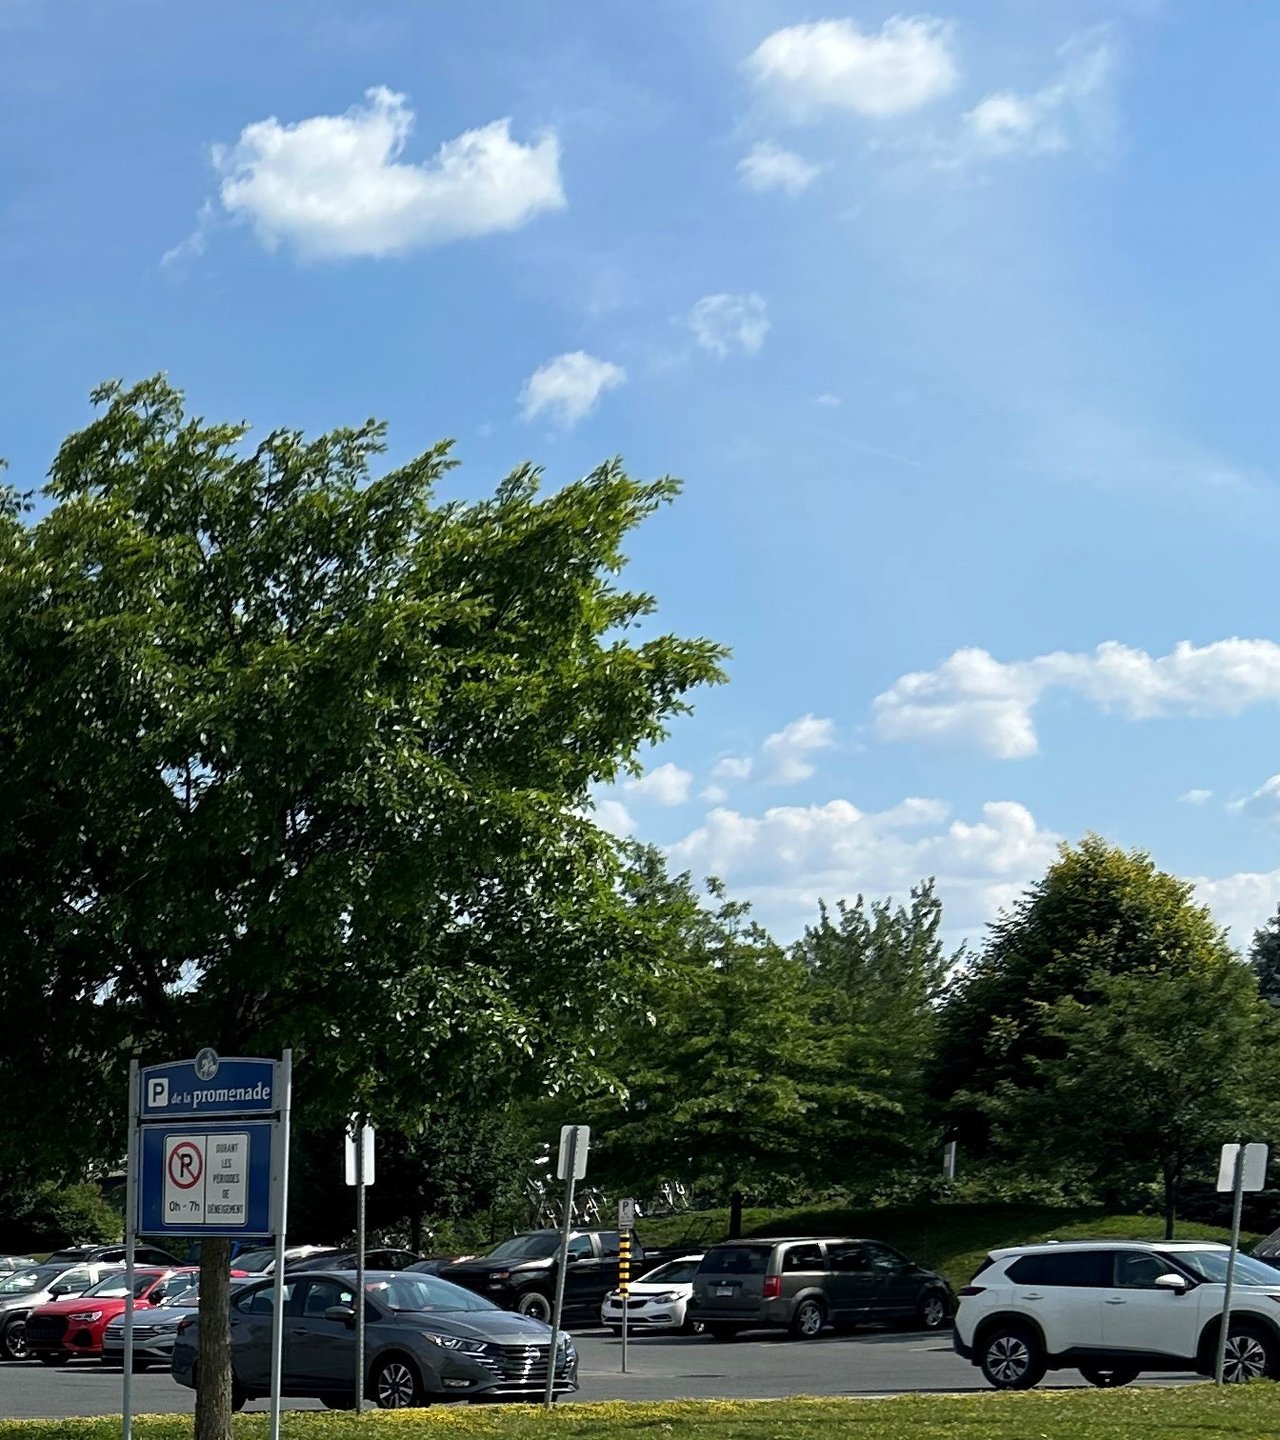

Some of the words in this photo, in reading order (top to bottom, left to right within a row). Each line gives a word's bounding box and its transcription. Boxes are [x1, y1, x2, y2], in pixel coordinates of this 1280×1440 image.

[153, 1082, 165, 1104] P
[170, 1092, 182, 1104] de
[183, 1092, 192, 1104] la
[192, 1081, 271, 1109] promenade
[215, 1143, 239, 1154] DURANT
[221, 1158, 232, 1169] LES
[221, 1189, 230, 1199] DE
[189, 1200, 201, 1212] 7h
